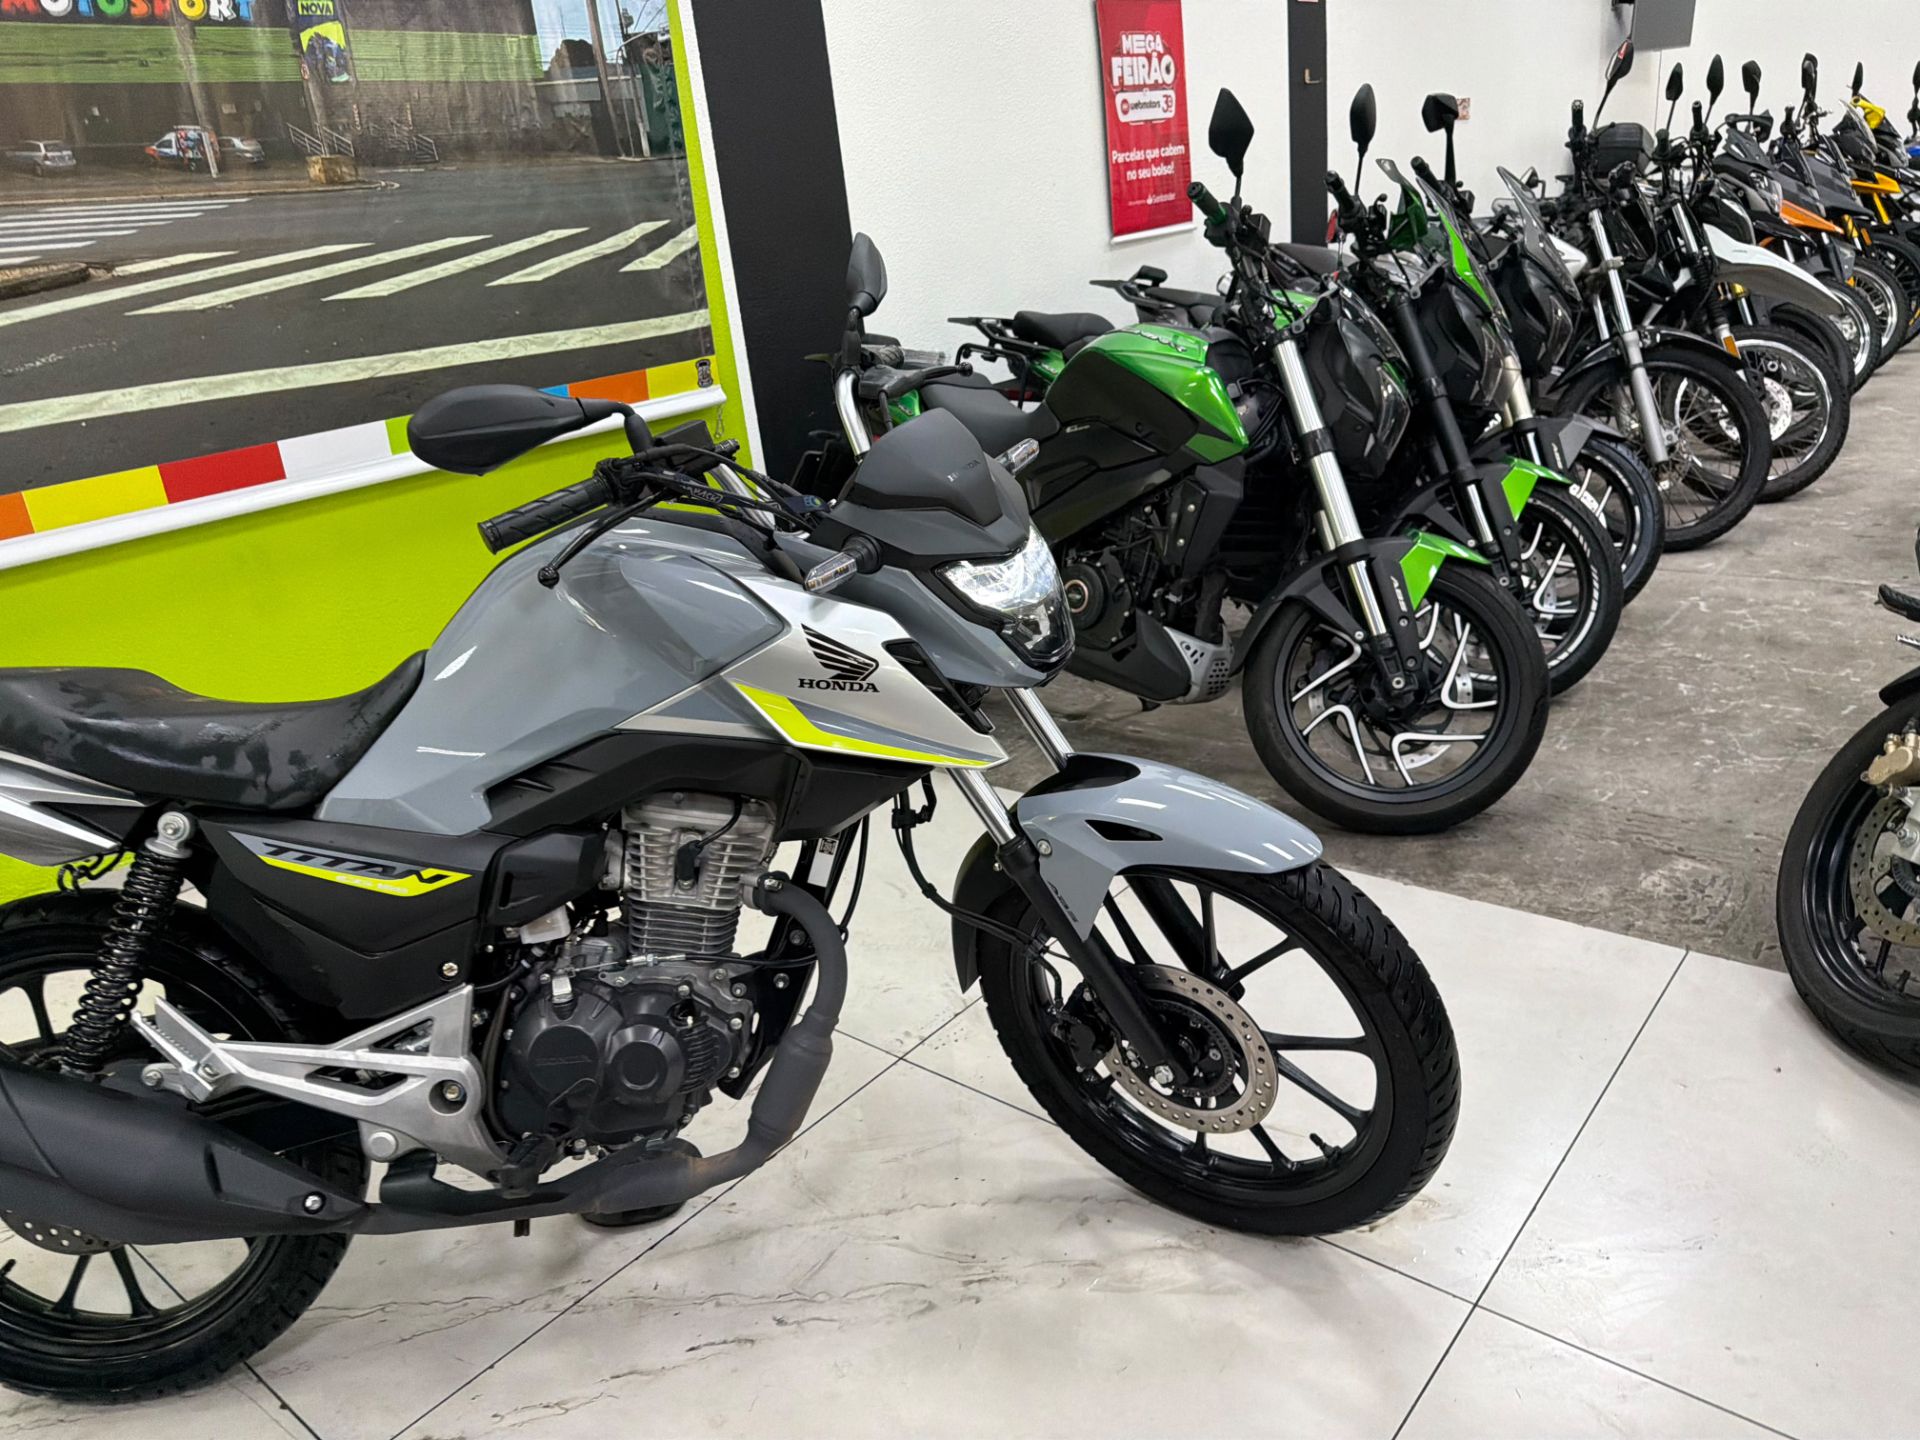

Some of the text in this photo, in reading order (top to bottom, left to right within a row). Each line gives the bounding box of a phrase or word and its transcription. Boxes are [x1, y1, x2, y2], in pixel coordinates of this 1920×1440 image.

[300, 3, 333, 15] NOVA
[1121, 34, 1164, 54] MEGA
[1111, 51, 1175, 86] FEIRÃO
[1111, 143, 1185, 164] Parcelas que cabem
[1126, 161, 1175, 181] no seu bolso!
[798, 678, 880, 693] HONDA
[263, 842, 450, 884] TITAN
